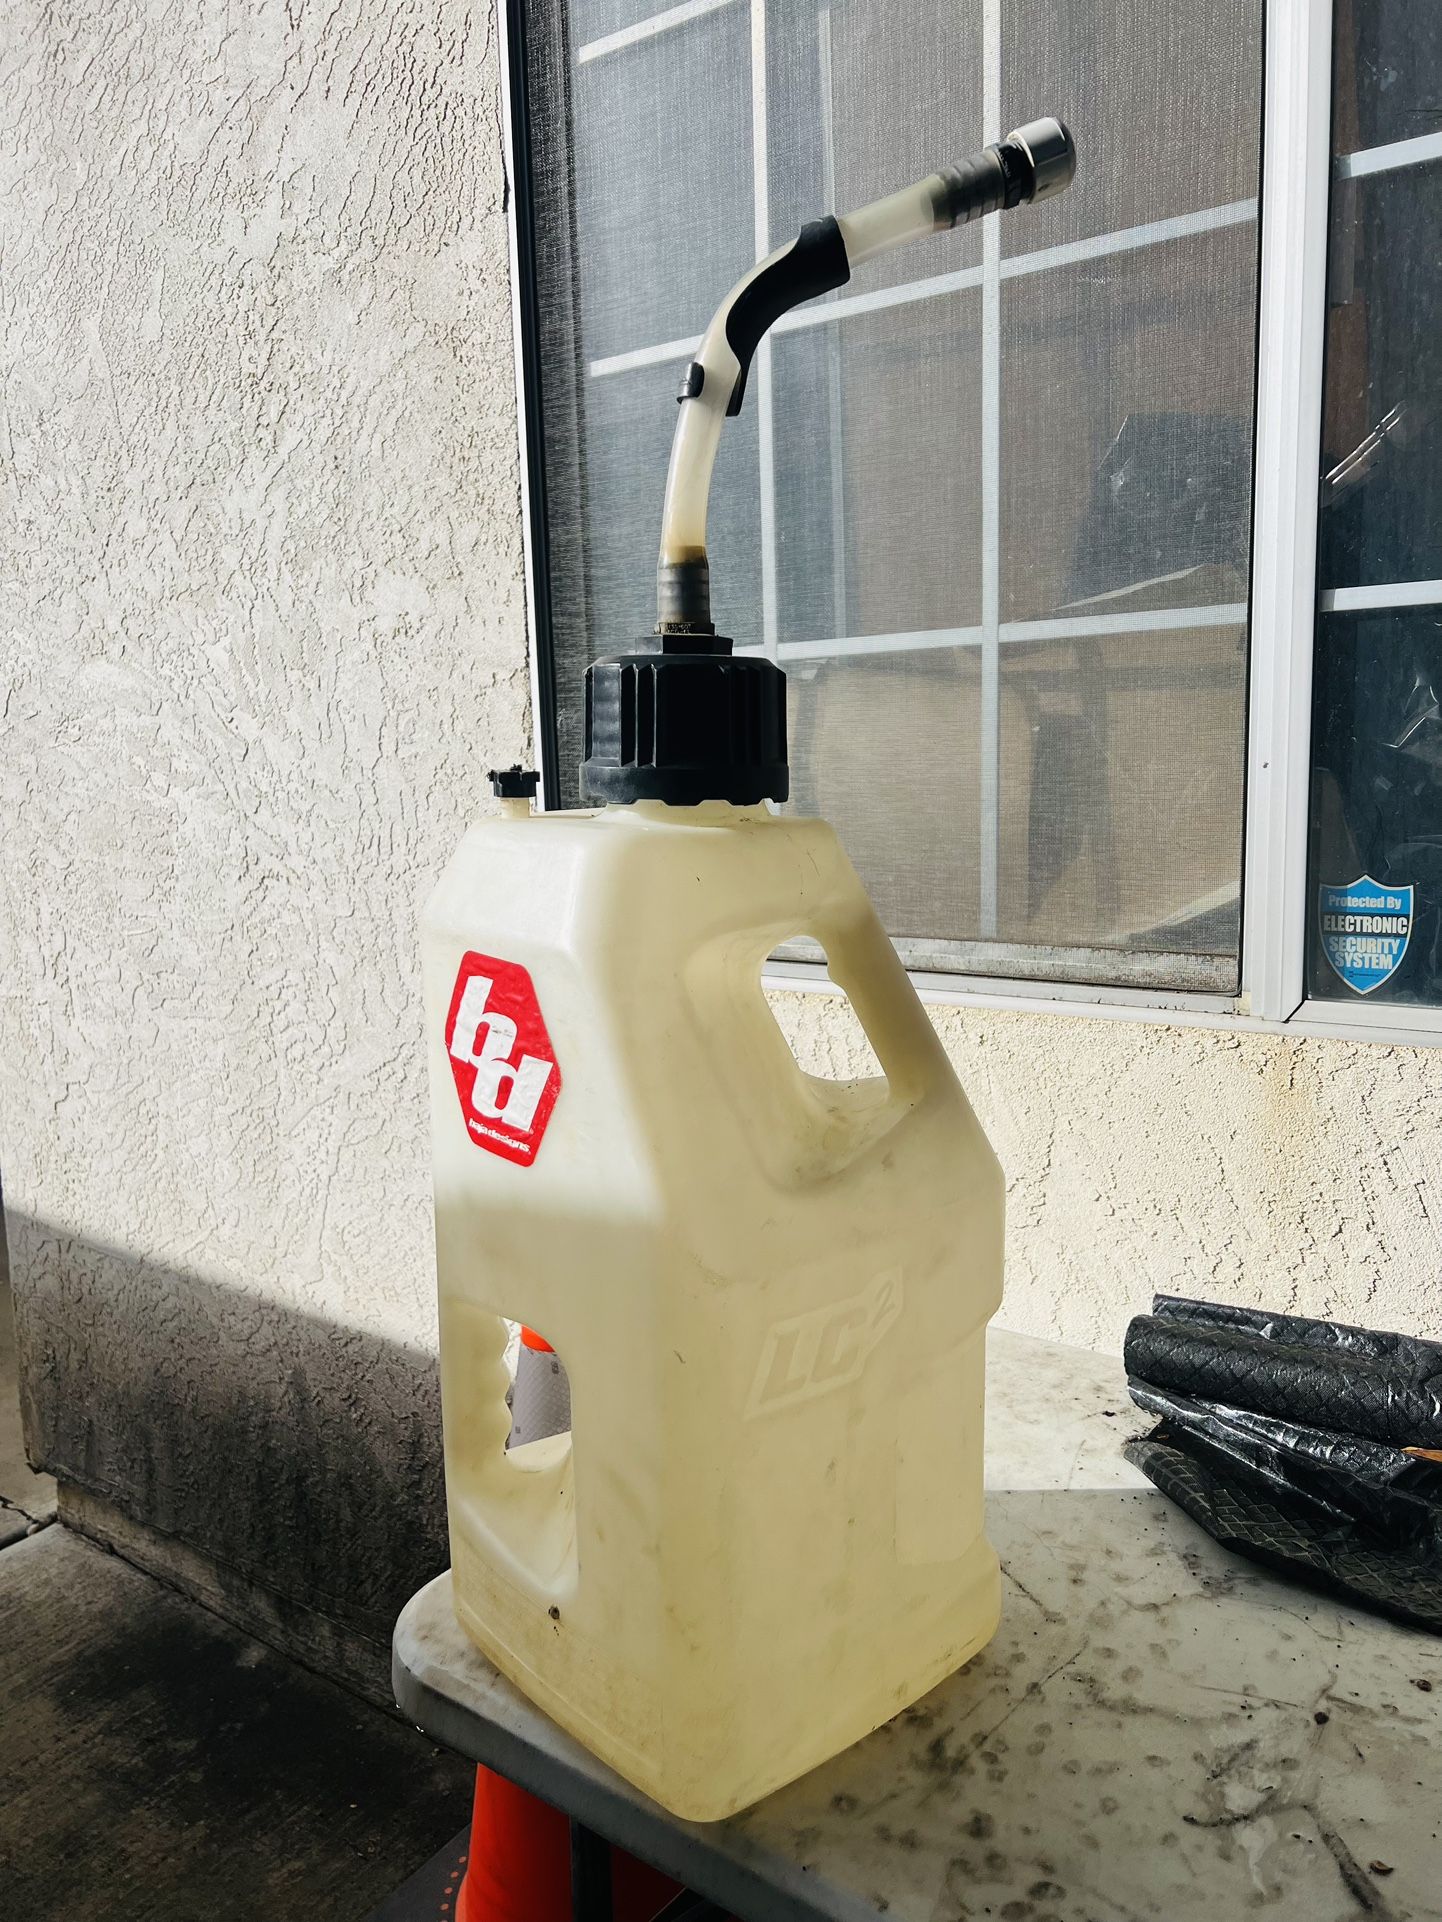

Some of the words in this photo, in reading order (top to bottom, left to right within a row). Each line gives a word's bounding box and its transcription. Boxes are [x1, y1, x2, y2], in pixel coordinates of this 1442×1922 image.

[1329, 895, 1384, 908] Protected
[1386, 896, 1401, 909] By
[1324, 915, 1407, 934] ELECTRONIC
[1328, 936, 1400, 954] SECURITY
[1335, 952, 1393, 969] SYSTEM
